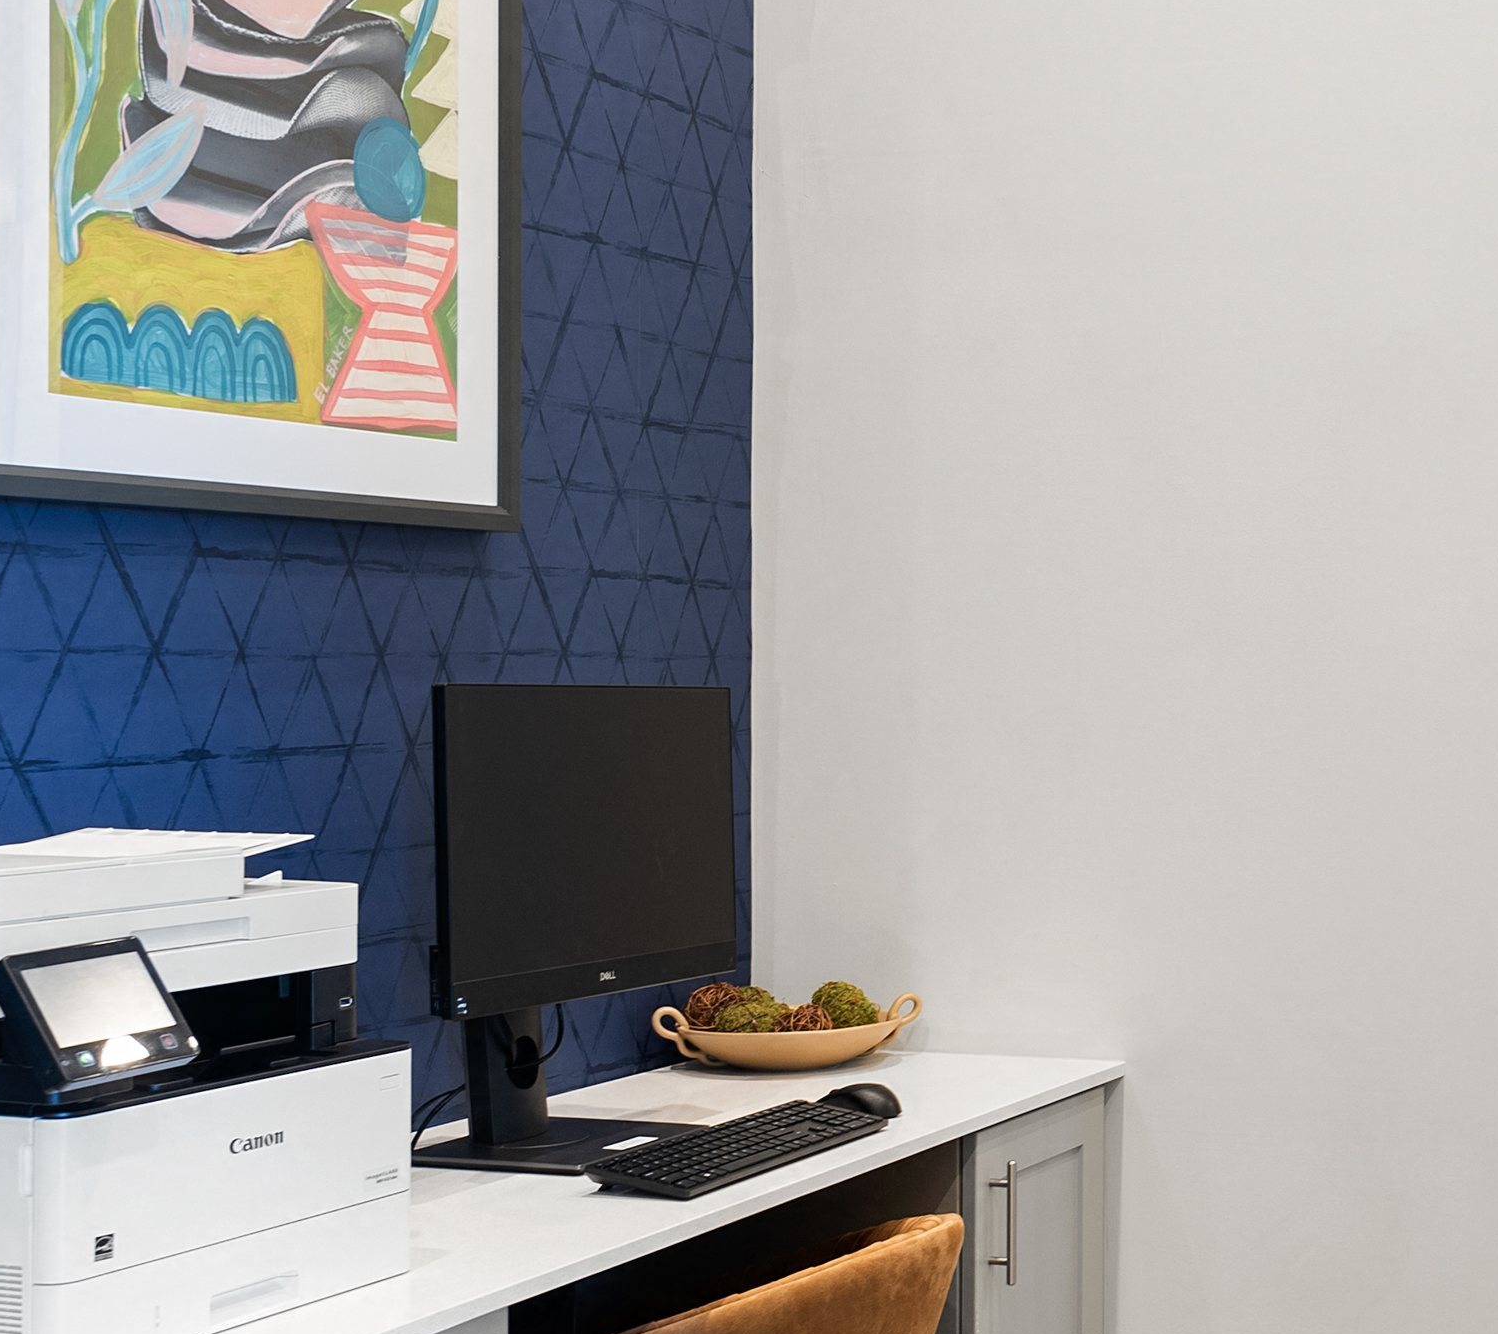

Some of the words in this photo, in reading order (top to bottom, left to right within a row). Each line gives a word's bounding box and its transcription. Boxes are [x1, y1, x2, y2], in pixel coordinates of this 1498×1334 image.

[325, 325, 354, 379] BAKER
[599, 970, 616, 981] DELL
[229, 1130, 285, 1155] Canon
